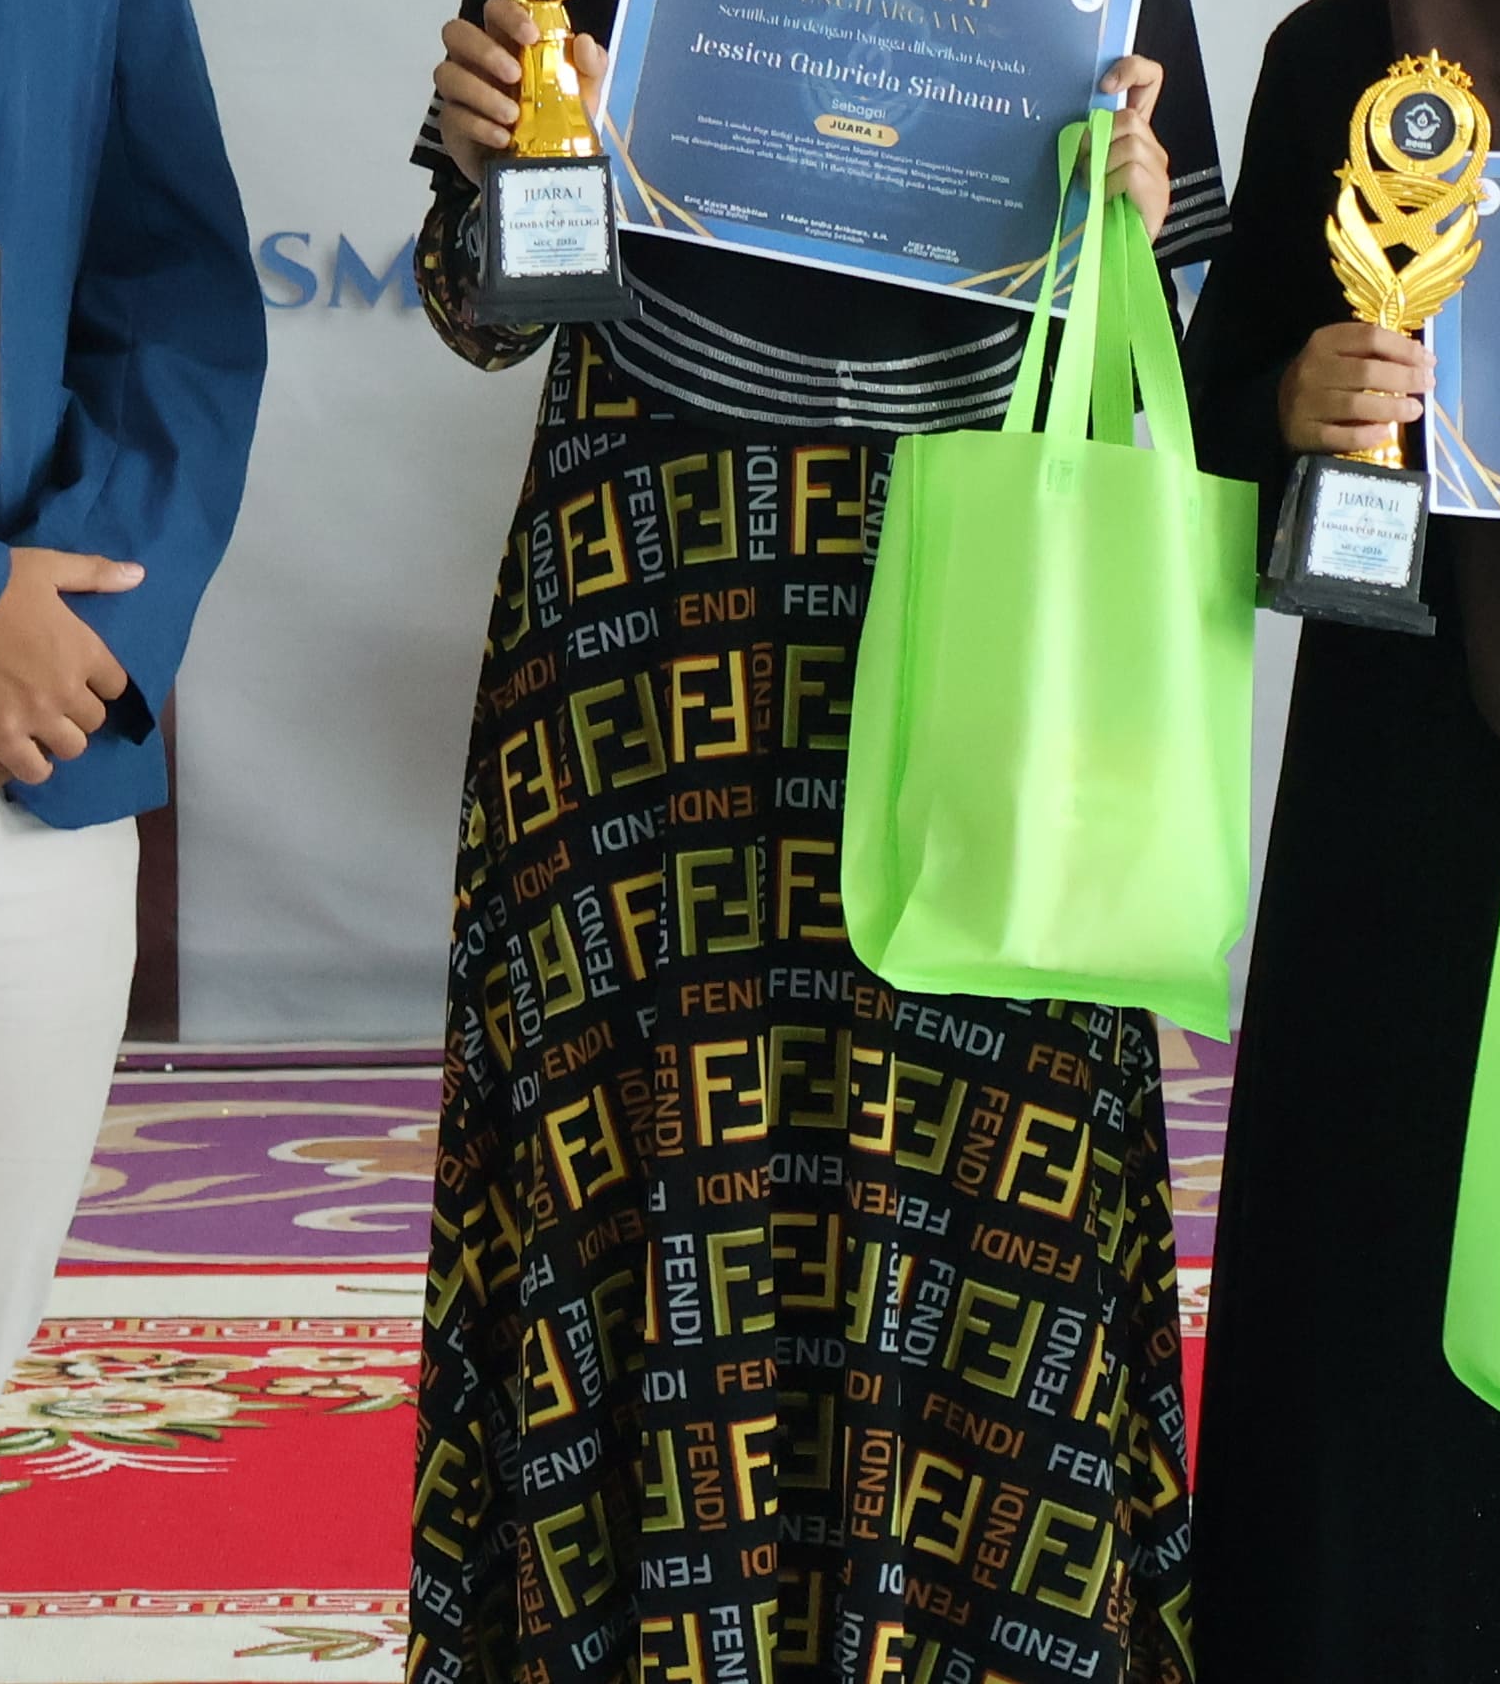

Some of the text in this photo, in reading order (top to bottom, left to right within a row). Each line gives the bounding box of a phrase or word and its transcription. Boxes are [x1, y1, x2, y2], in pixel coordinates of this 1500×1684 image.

[690, 32, 1041, 121] Jessica Gabriela Siahaan V.
[718, 2, 780, 28] Sertifikat
[802, 16, 852, 44] dengan
[855, 27, 905, 56] bangga
[907, 35, 972, 66] diberikan
[974, 48, 1027, 77] kepada
[830, 119, 885, 141] JUARA 1
[831, 97, 887, 121] Sebagai
[524, 188, 574, 202] JUARA
[546, 220, 565, 230] POP
[259, 231, 425, 309] SM
[624, 465, 666, 584] FENDI
[746, 445, 778, 562] FENDI
[1337, 491, 1385, 511] JUARA
[532, 510, 563, 628] FENDI
[506, 934, 545, 1048] FENDI
[573, 885, 620, 999] FENDI
[894, 1001, 1006, 1063] FENDI
[654, 1043, 685, 1158] FENDI
[951, 1084, 1009, 1198] FENDI
[662, 1233, 704, 1347] FENDI
[970, 1223, 1083, 1284] FENDI
[558, 1297, 603, 1408] FENDI
[900, 1258, 958, 1368] FENDI
[1027, 1306, 1088, 1417] FENDI
[522, 1427, 601, 1496] FENDI
[684, 1421, 730, 1532] FENDI
[921, 1392, 1026, 1459] FENDI
[851, 1428, 895, 1540] FENDI
[971, 1481, 1030, 1591] FENDI
[990, 1614, 1101, 1680] FENDI
